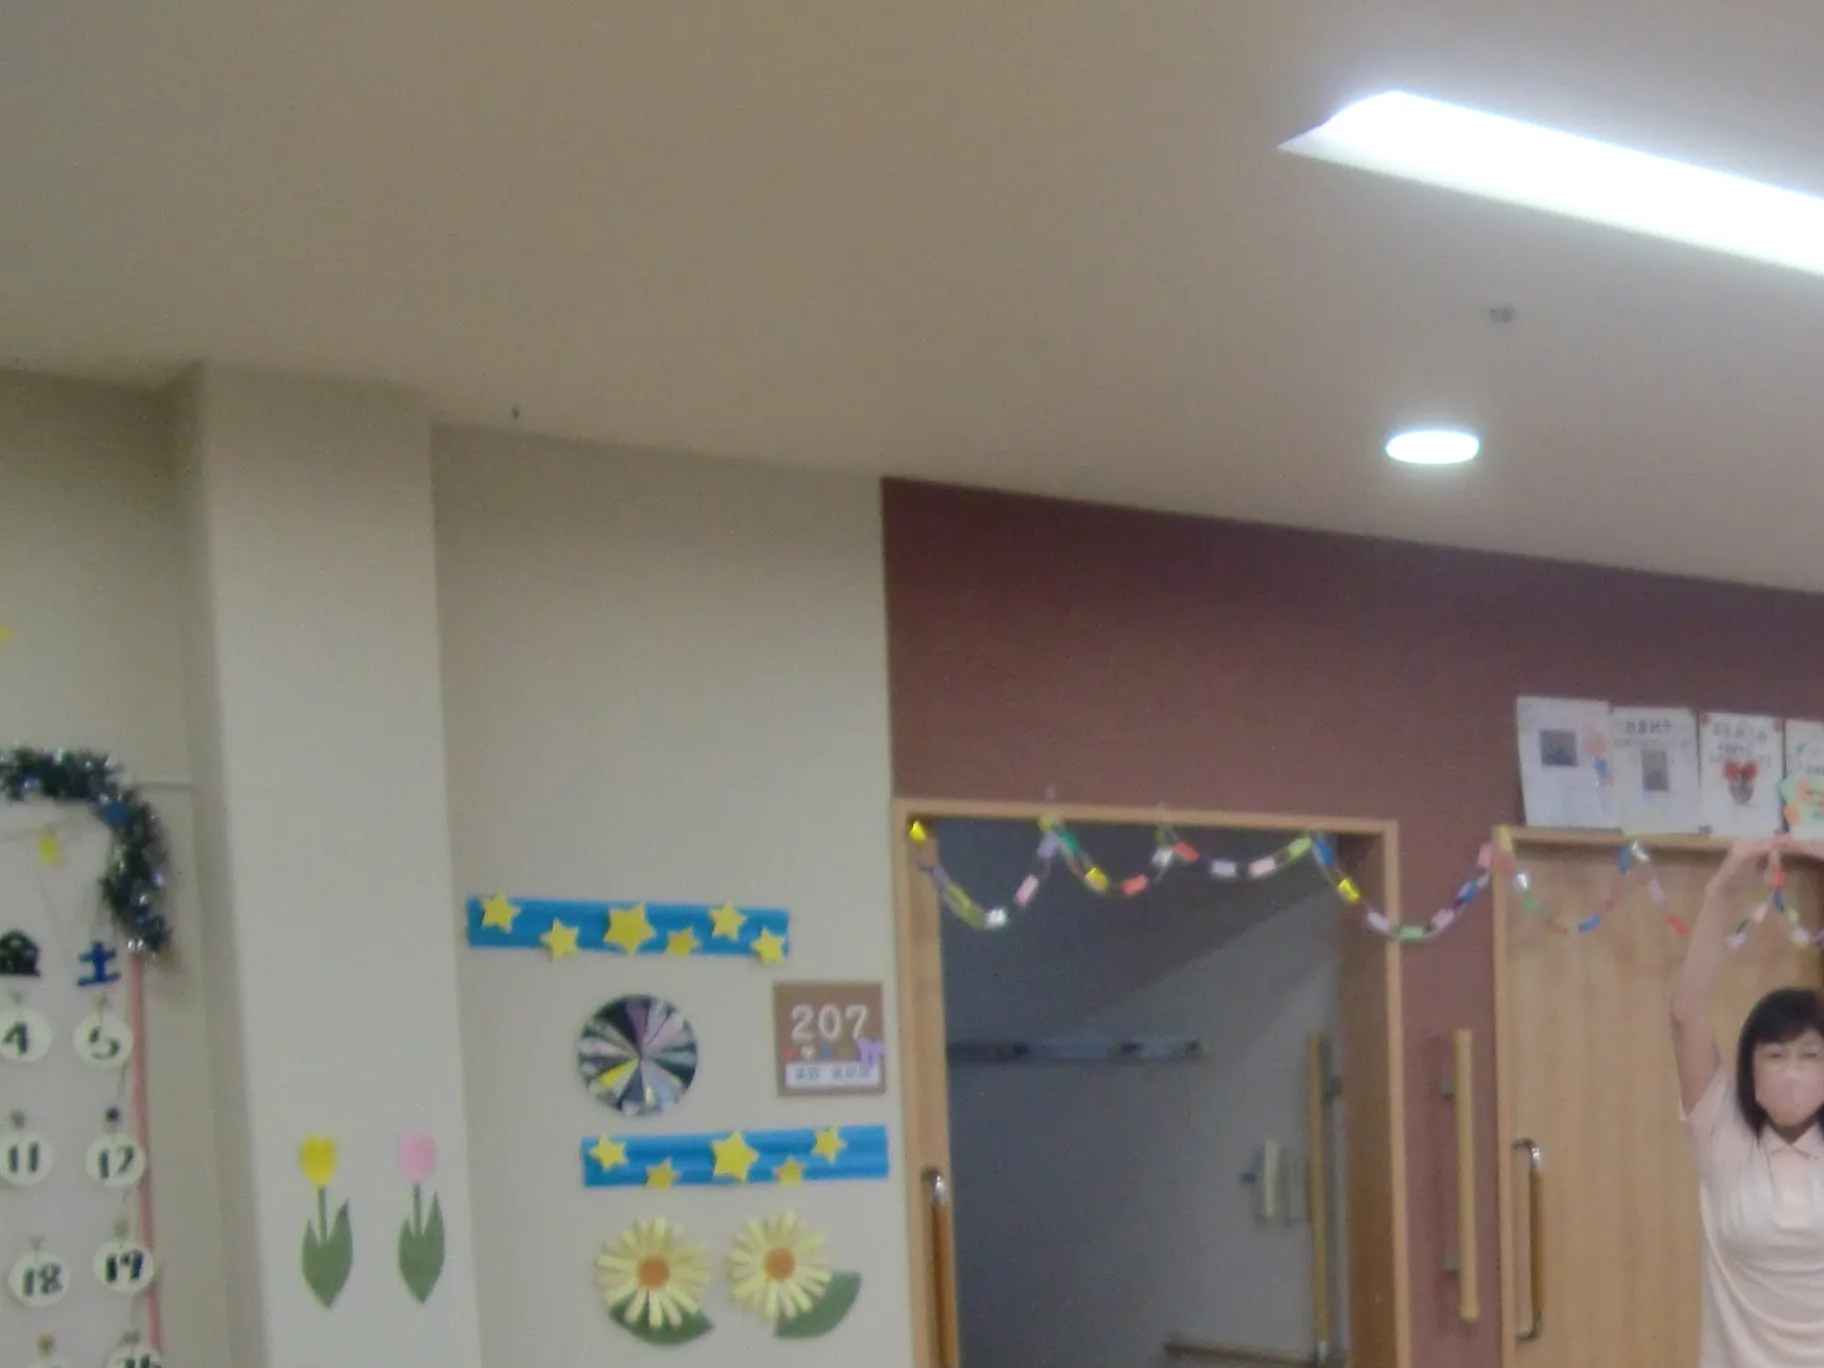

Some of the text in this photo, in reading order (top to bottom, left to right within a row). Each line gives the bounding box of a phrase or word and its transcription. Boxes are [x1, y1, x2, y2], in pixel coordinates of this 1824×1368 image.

[0, 930, 121, 987] 金 土
[1, 1020, 121, 1060] 4 5
[791, 1003, 869, 1042] 207
[8, 1142, 39, 1173] 11
[22, 1250, 143, 1297] 18 19
